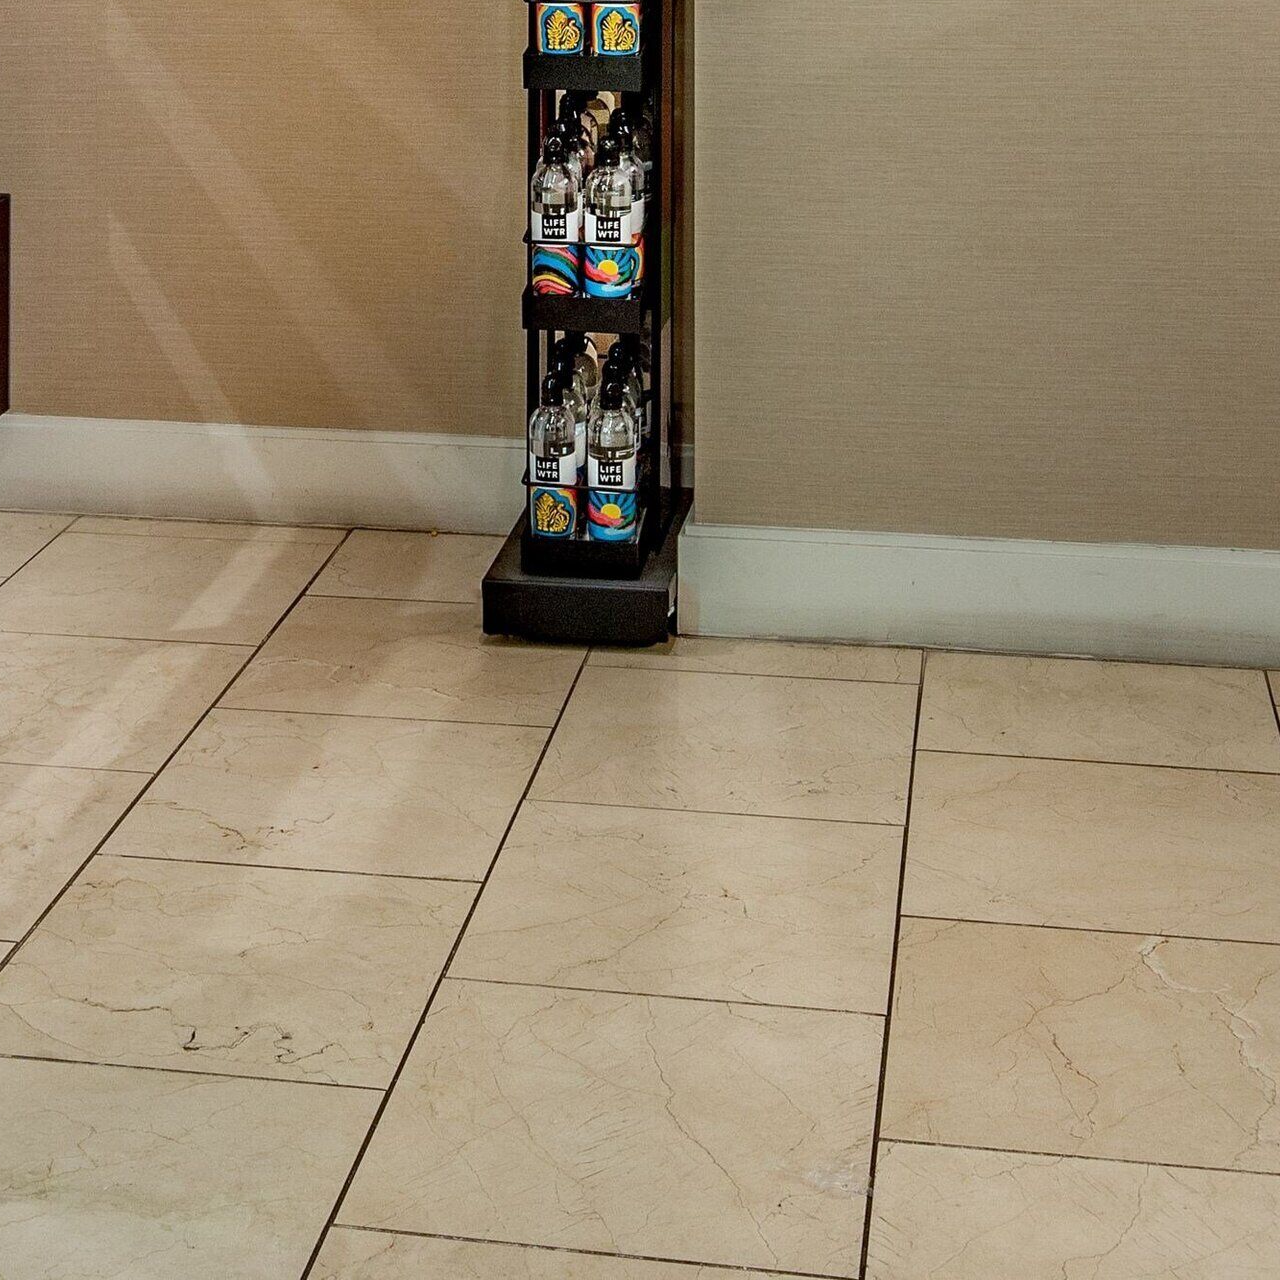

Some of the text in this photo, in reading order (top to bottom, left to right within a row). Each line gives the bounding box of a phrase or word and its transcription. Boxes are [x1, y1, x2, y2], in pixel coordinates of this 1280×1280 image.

[543, 218, 565, 227] LIFE
[597, 221, 619, 230] LIFE
[543, 227, 566, 236] WTR
[597, 229, 620, 239] WTR
[536, 461, 558, 470] LIFE
[600, 465, 622, 474] LIFE
[536, 470, 558, 479] WTR
[600, 474, 622, 484] WTR
